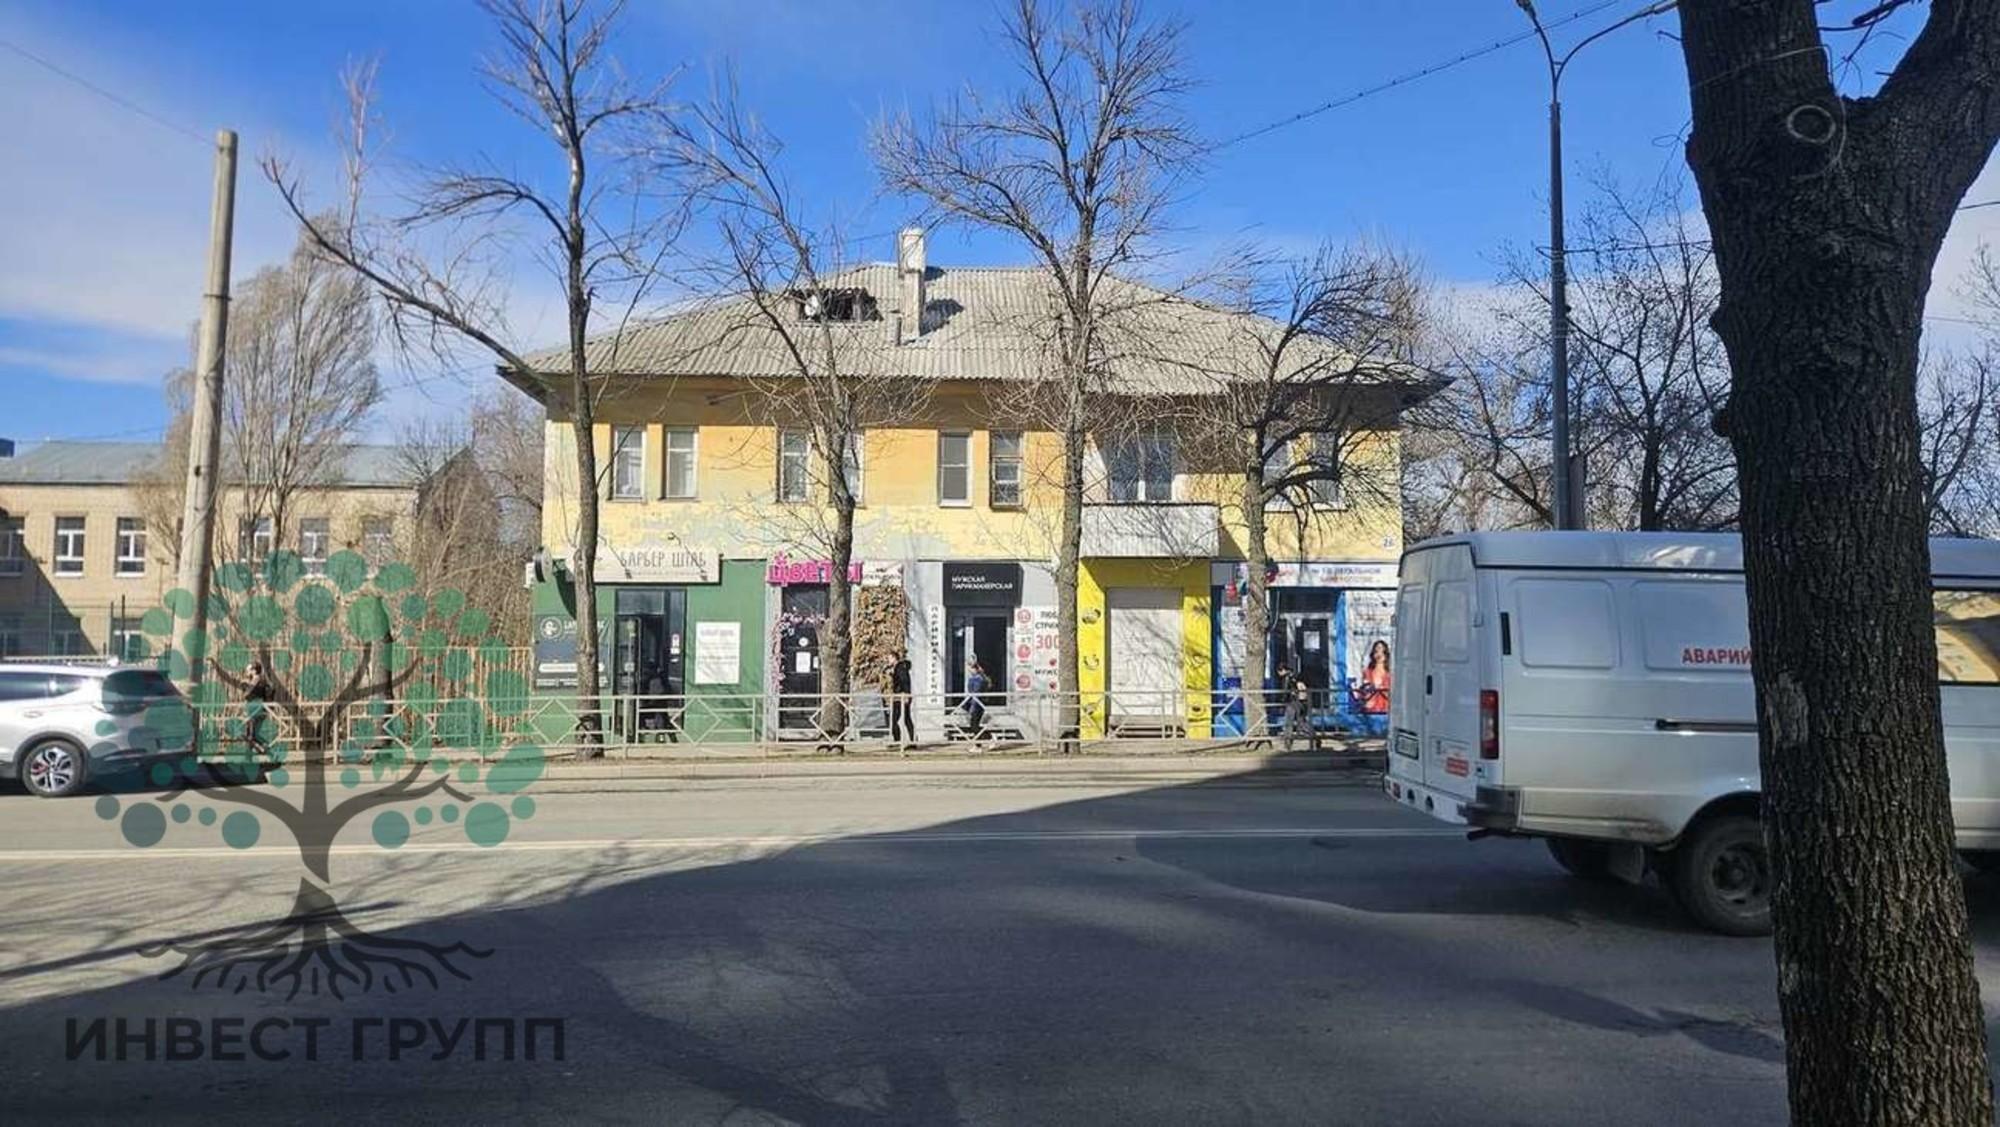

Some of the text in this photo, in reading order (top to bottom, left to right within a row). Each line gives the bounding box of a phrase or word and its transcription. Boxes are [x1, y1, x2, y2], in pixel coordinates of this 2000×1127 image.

[620, 551, 665, 568] БАРБЕР
[951, 575, 985, 583] МУЖСКАЯ
[951, 582, 1014, 590] ПАРИКМАХЕРСКАЯ
